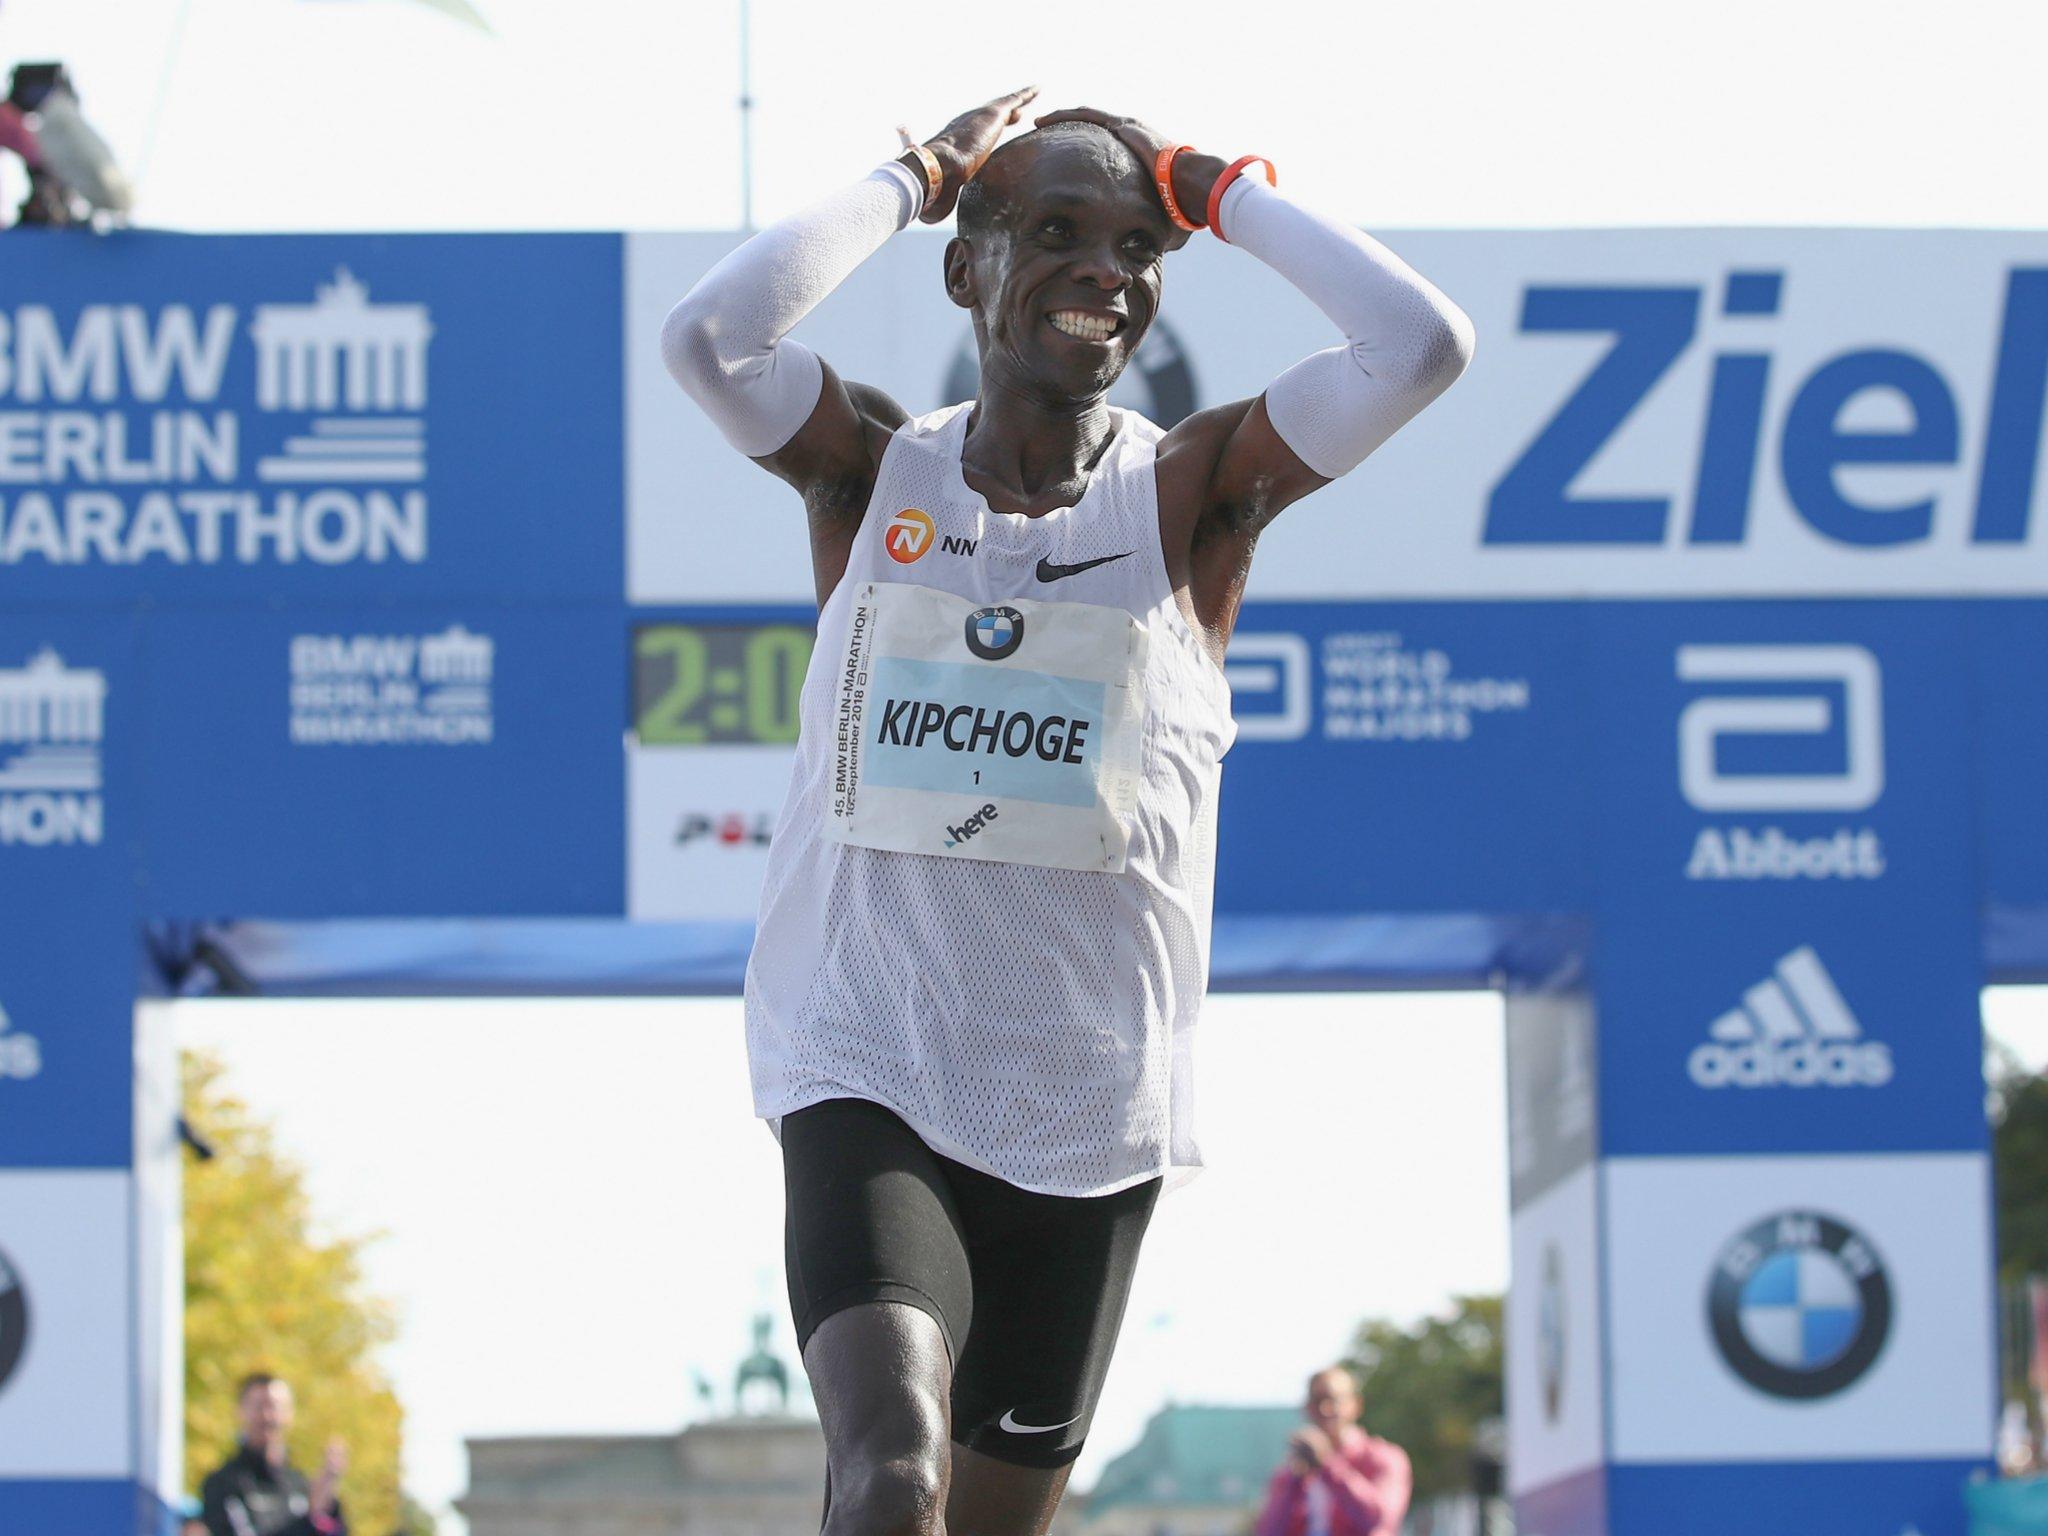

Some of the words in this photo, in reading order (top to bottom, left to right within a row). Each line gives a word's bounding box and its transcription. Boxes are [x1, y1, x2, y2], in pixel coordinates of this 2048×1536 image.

[0, 304, 236, 402] MW
[1481, 264, 2048, 548] Ziel
[0, 490, 427, 564] ARATHON
[941, 535, 978, 557] NN
[973, 608, 1022, 622] BMW
[837, 606, 867, 752] BERLIN-MARATHON
[852, 690, 865, 722] 2018
[878, 699, 1090, 764] KIPCHOGE
[835, 755, 849, 793] BMW
[973, 770, 981, 786] 1
[834, 796, 846, 817] 45.
[946, 803, 999, 844] here
[1685, 828, 1886, 880] Abbott
[1687, 1036, 1894, 1088] adidas
